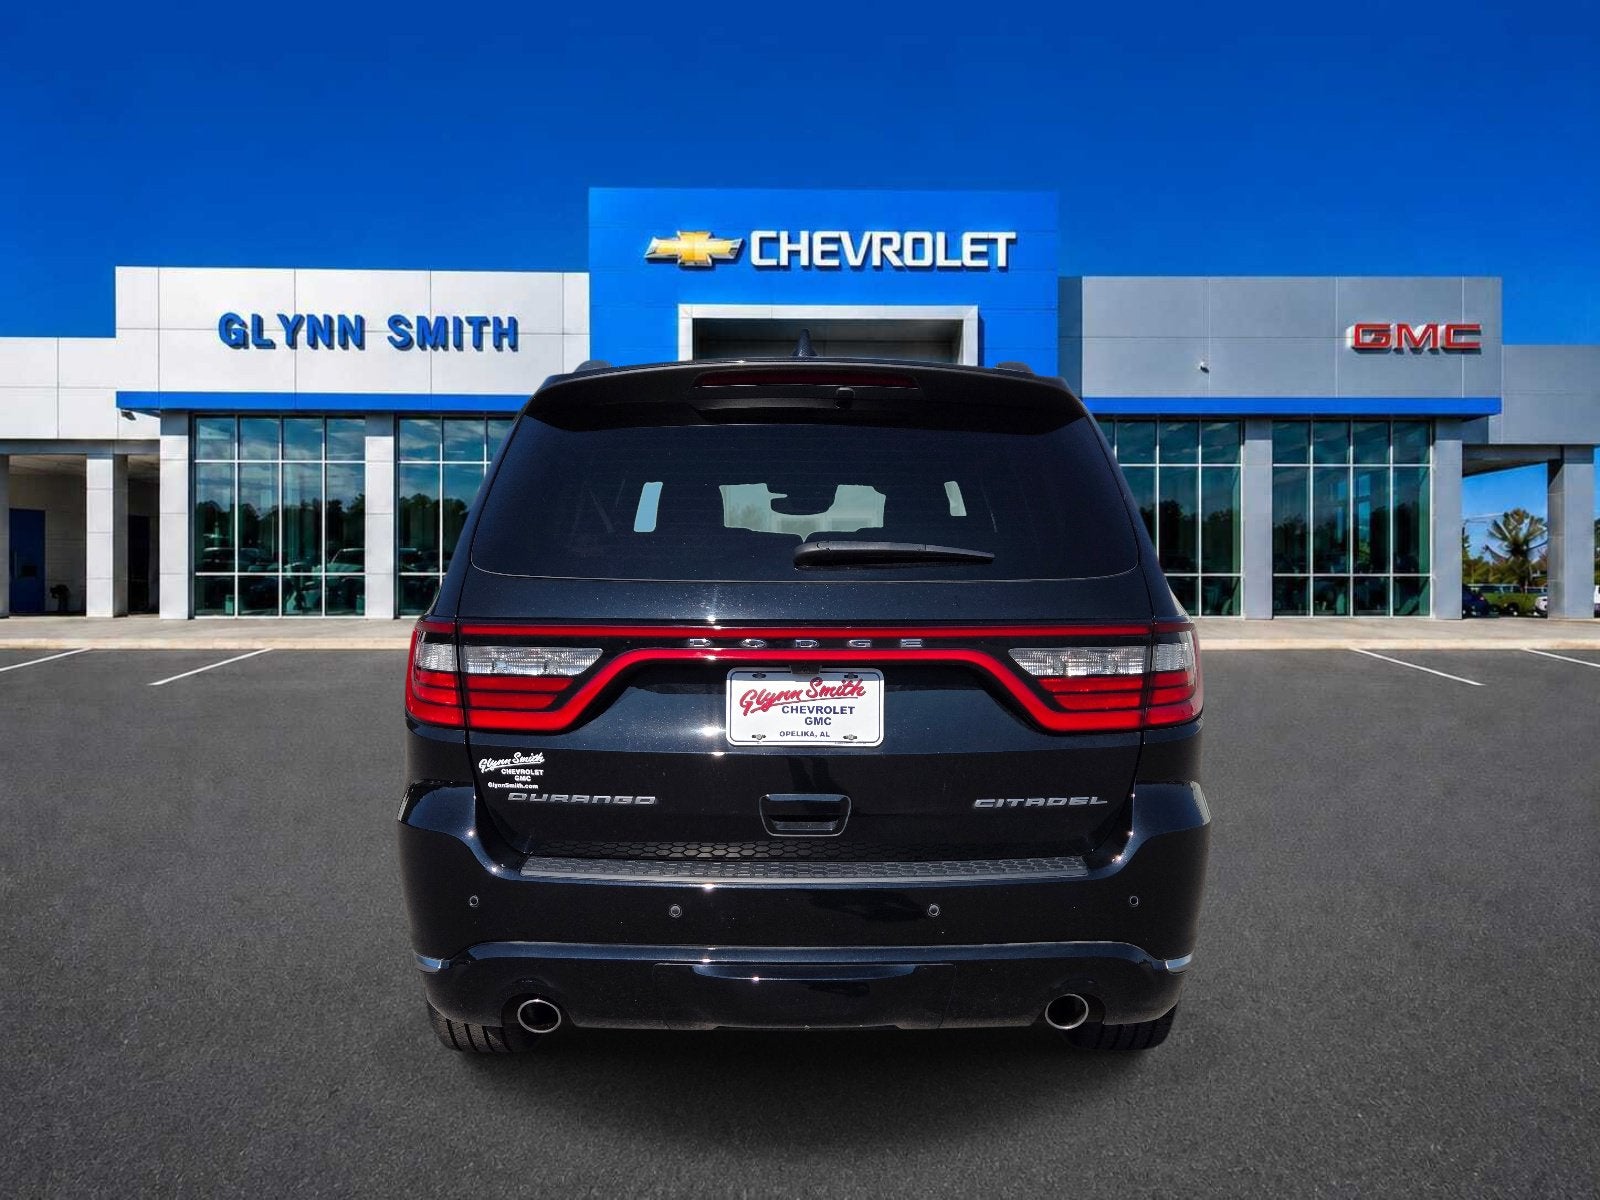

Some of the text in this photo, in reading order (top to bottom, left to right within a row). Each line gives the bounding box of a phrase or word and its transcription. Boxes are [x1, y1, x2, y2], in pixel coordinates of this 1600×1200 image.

[750, 230, 1017, 270] CHEVROLET
[219, 312, 519, 352] GLYNN SMITH
[1348, 323, 1482, 353] GMC
[689, 638, 923, 648] DODGE
[739, 676, 867, 716] Glynn Smith
[781, 705, 856, 715] CHEVROLET
[804, 716, 832, 726] GMC
[779, 730, 831, 738] OPELIKA, AL
[478, 752, 545, 773] Glynn Smith
[501, 768, 545, 776] CHEVROLET
[508, 792, 656, 805] DURANGO
[974, 796, 1108, 808] CITADEL
